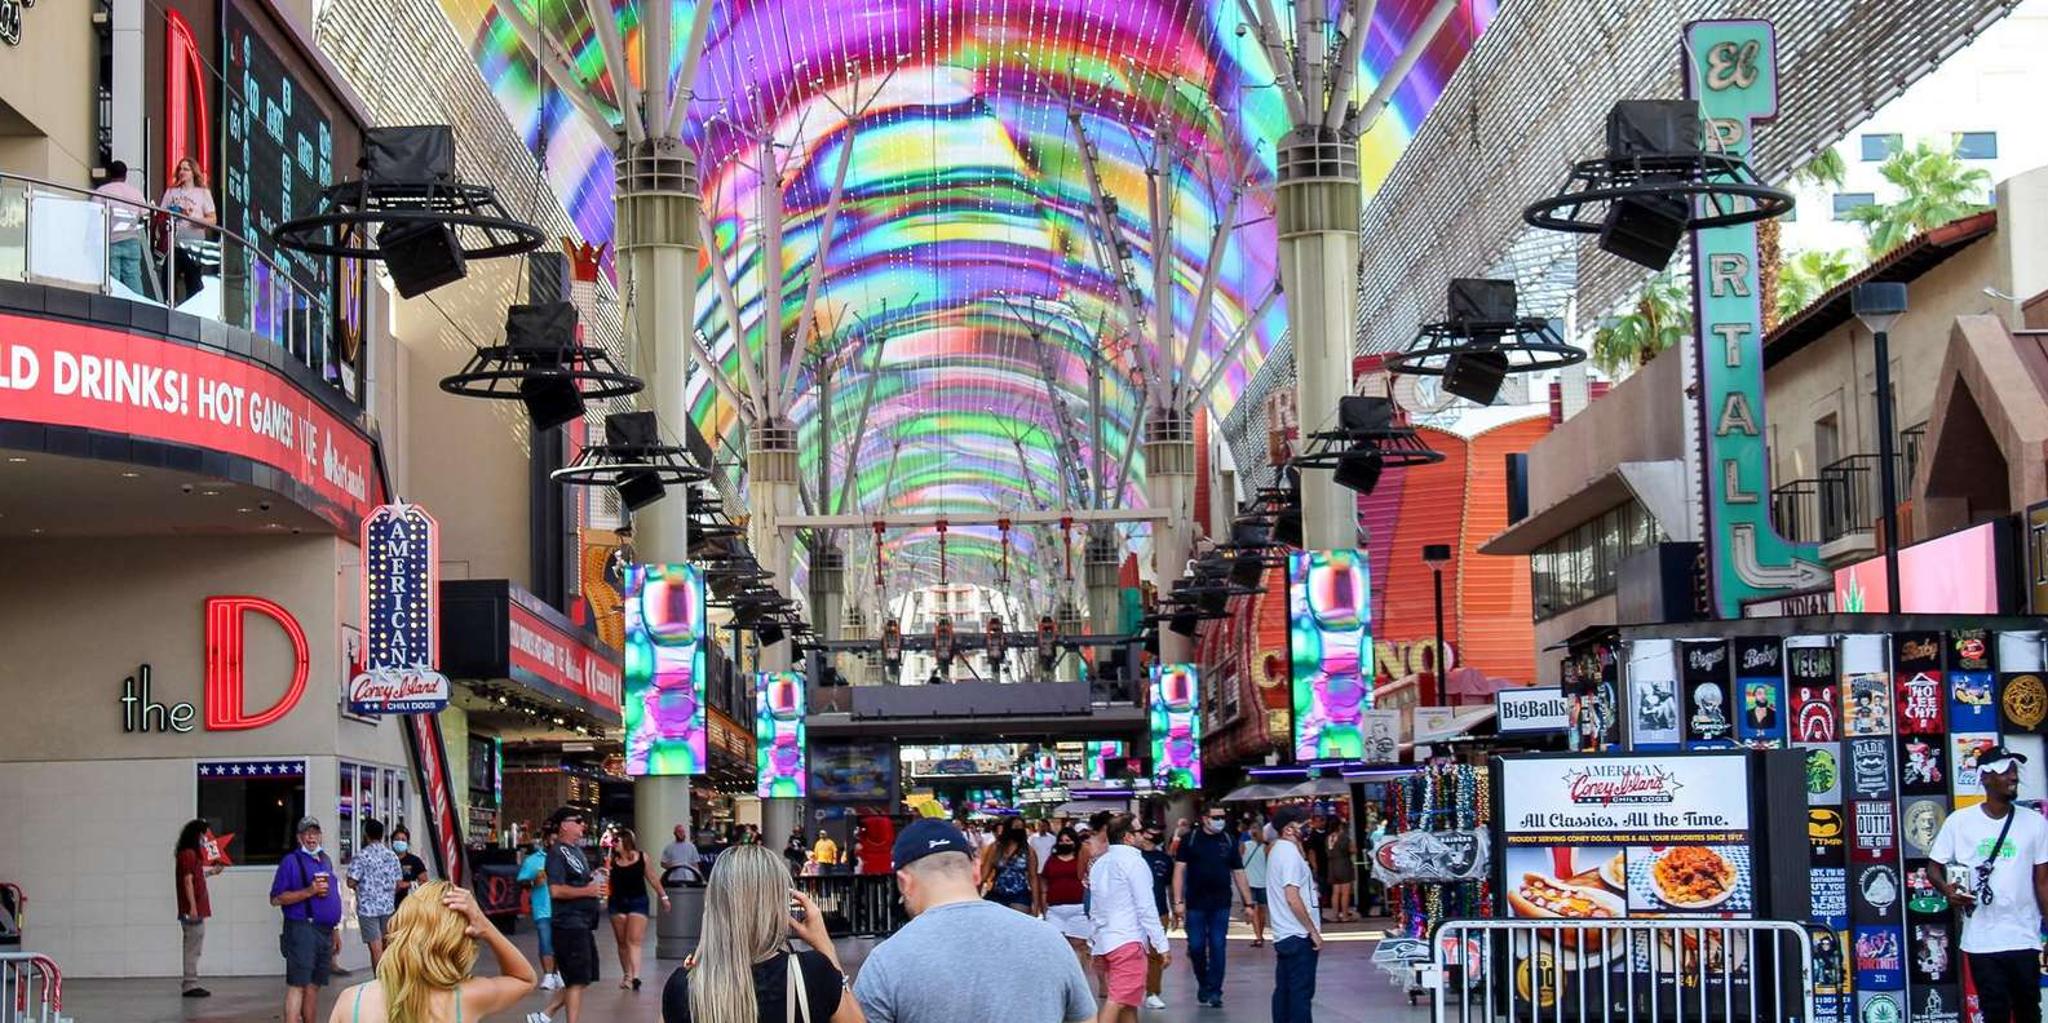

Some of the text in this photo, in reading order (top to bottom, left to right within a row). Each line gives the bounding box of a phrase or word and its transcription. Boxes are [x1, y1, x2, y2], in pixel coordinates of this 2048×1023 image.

[1705, 39, 1760, 91] El
[53, 351, 189, 416] DRINKS!
[198, 377, 244, 428] HOT
[250, 392, 293, 449] GAMES!
[387, 522, 409, 665] AMERICAN
[1781, 593, 1829, 617] INDIAN
[119, 595, 310, 732] the D
[1792, 649, 1832, 677] VEGAS
[354, 675, 440, 704] Coney Island
[1912, 685, 1933, 697] HO
[387, 702, 436, 710] CHILI DOGS
[1502, 699, 1566, 721] BigBalls
[1907, 697, 1937, 708] LEE
[1583, 764, 1665, 778] AMERICAN
[1571, 771, 1666, 804] Coney Island
[1856, 802, 1892, 814] STRAIGHT
[1520, 811, 1729, 828] All Classics. All the Time.
[1858, 815, 1891, 833] OUTTA
[1671, 834, 1705, 842] FAVORITES
[1860, 836, 1875, 847] THE
[1811, 909, 1847, 917] ONIGHT
